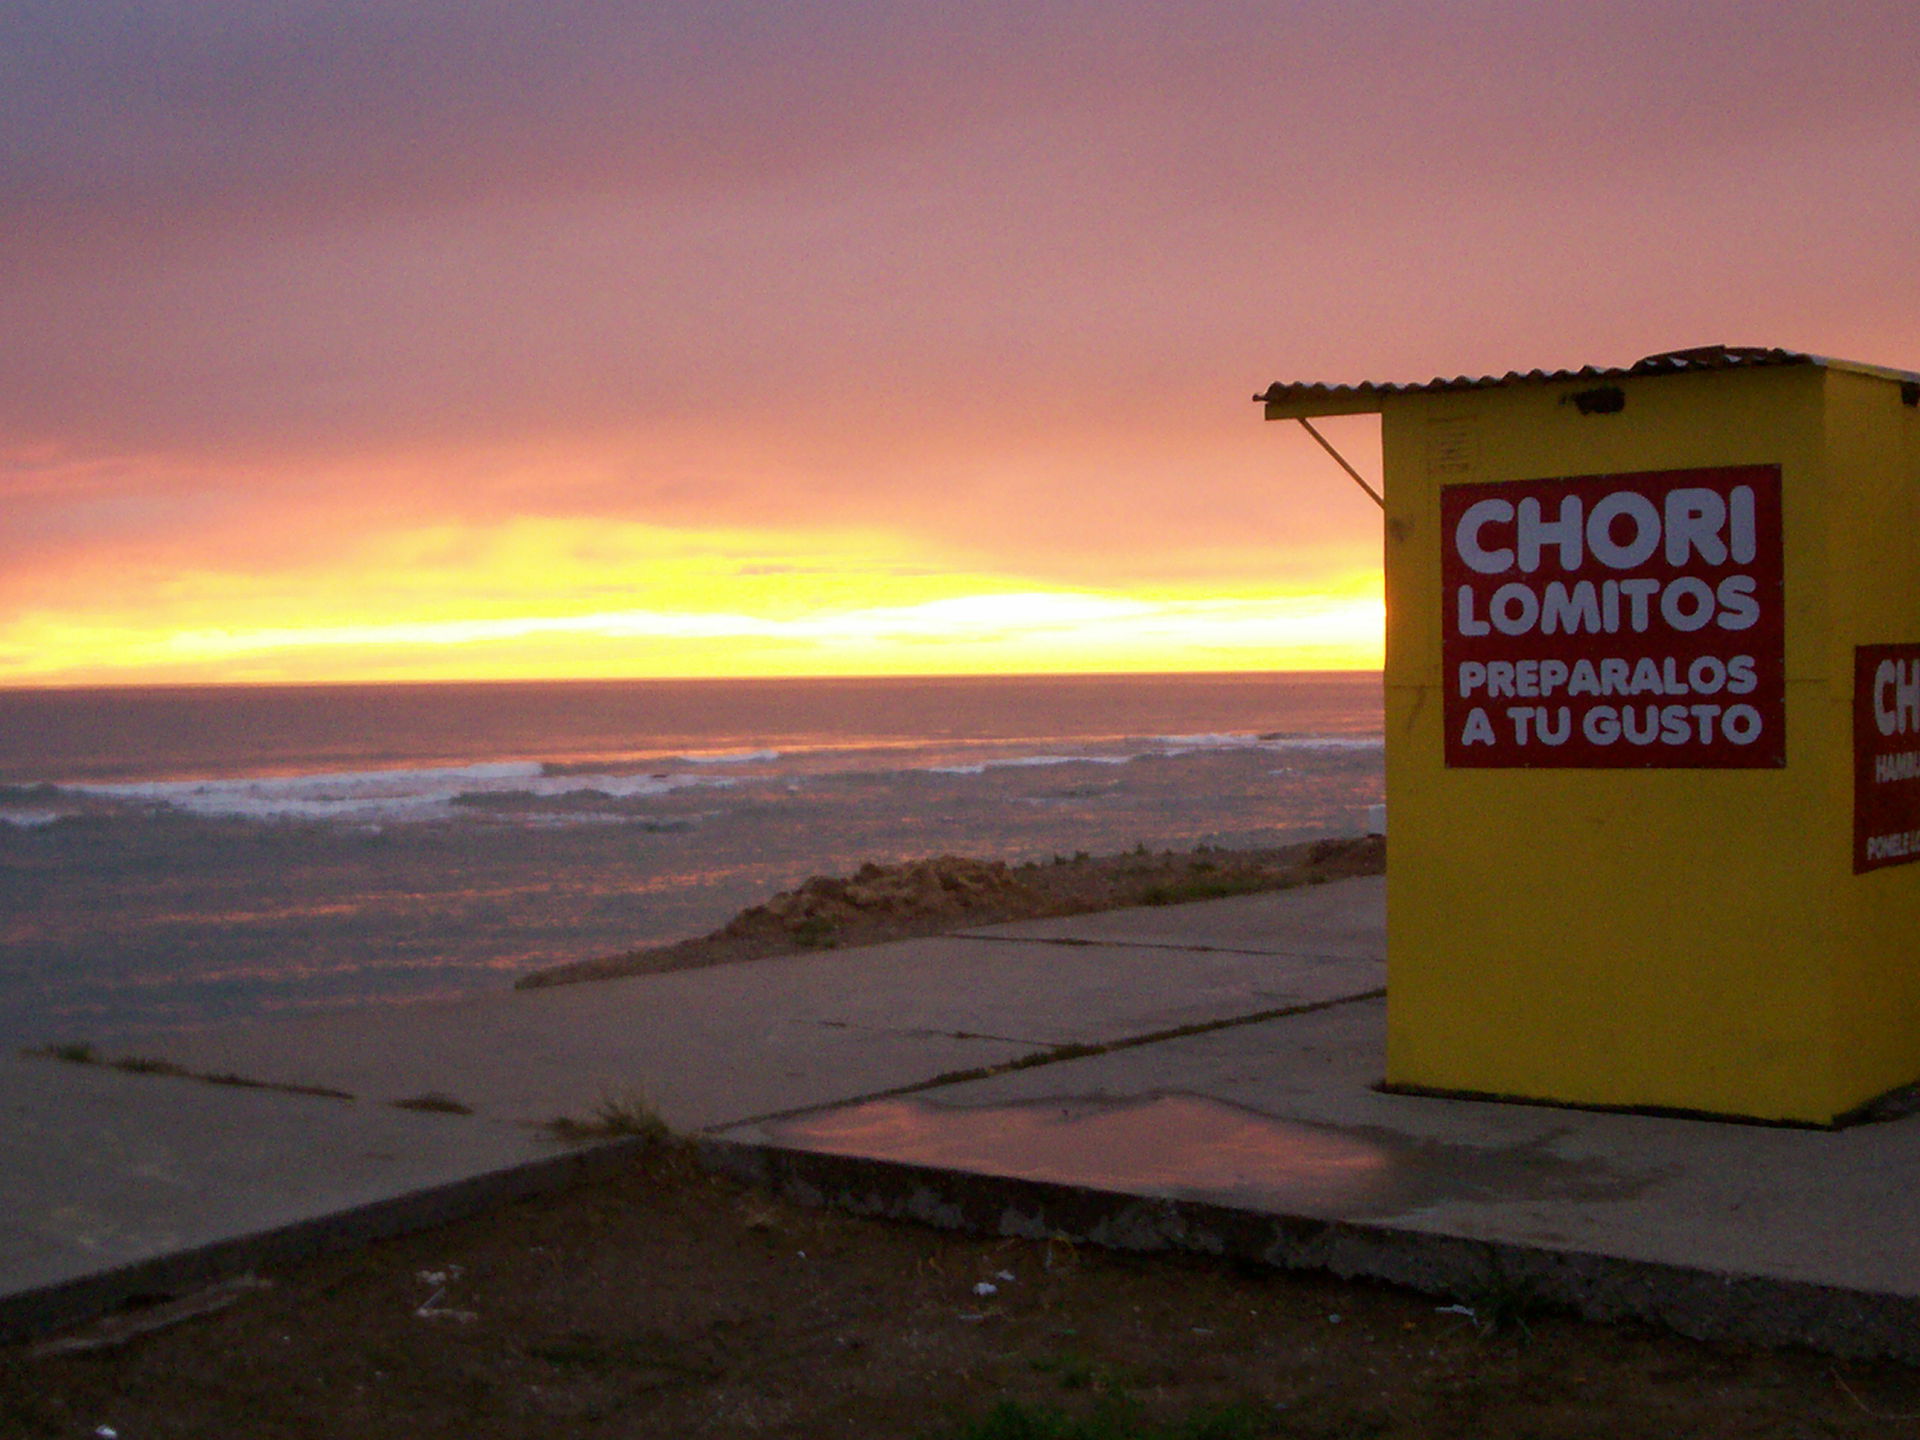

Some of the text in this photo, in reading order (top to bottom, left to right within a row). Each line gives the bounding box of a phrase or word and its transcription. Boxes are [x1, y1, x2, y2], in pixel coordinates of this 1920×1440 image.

[1455, 485, 1757, 575] CHORI
[1457, 574, 1761, 637] LOMITOS
[1458, 656, 1758, 698] PREPARALOS
[1461, 703, 1763, 747] A TU GUSTO
